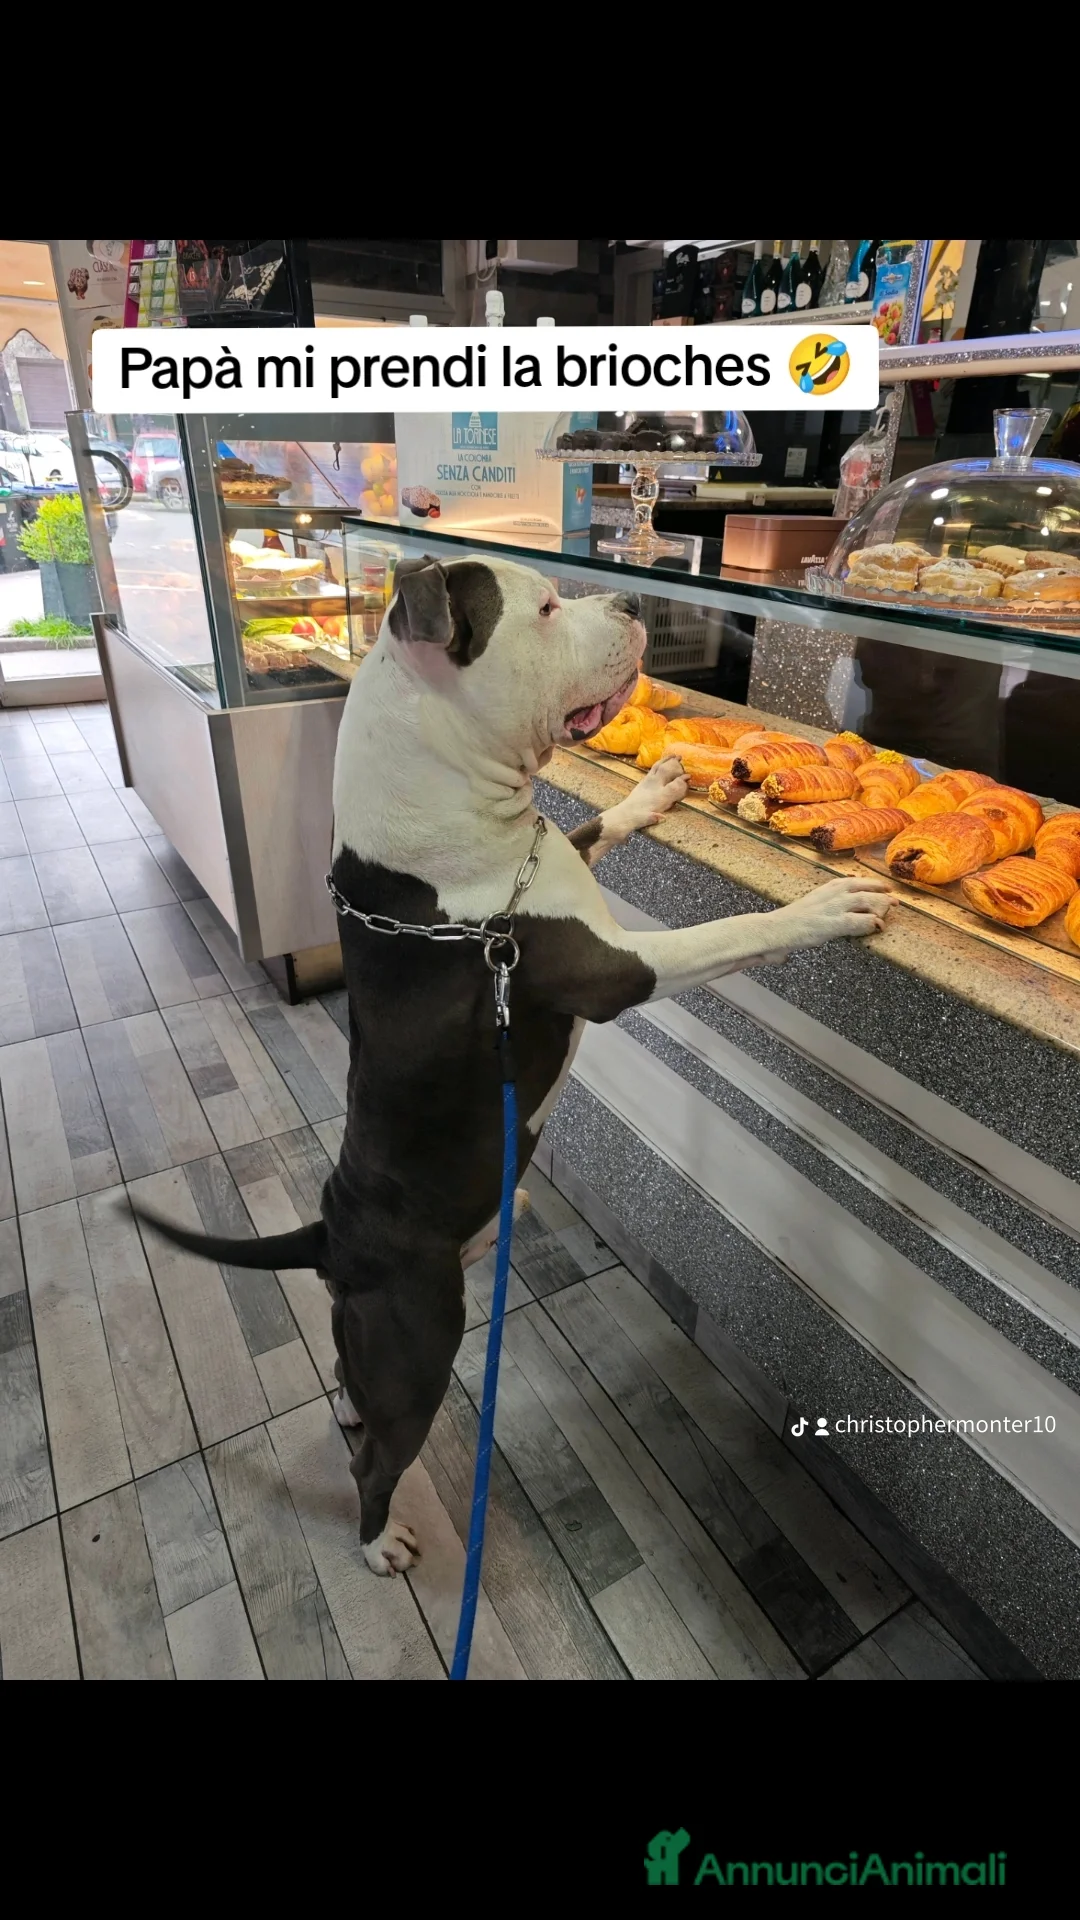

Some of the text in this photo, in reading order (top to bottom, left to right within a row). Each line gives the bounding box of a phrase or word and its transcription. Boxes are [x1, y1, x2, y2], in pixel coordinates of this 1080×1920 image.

[453, 427, 496, 445] LA TORINESE
[464, 454, 492, 462] COLOMBA
[437, 465, 515, 483] SENZA CANDITI
[800, 554, 825, 564] LAVAZZA
